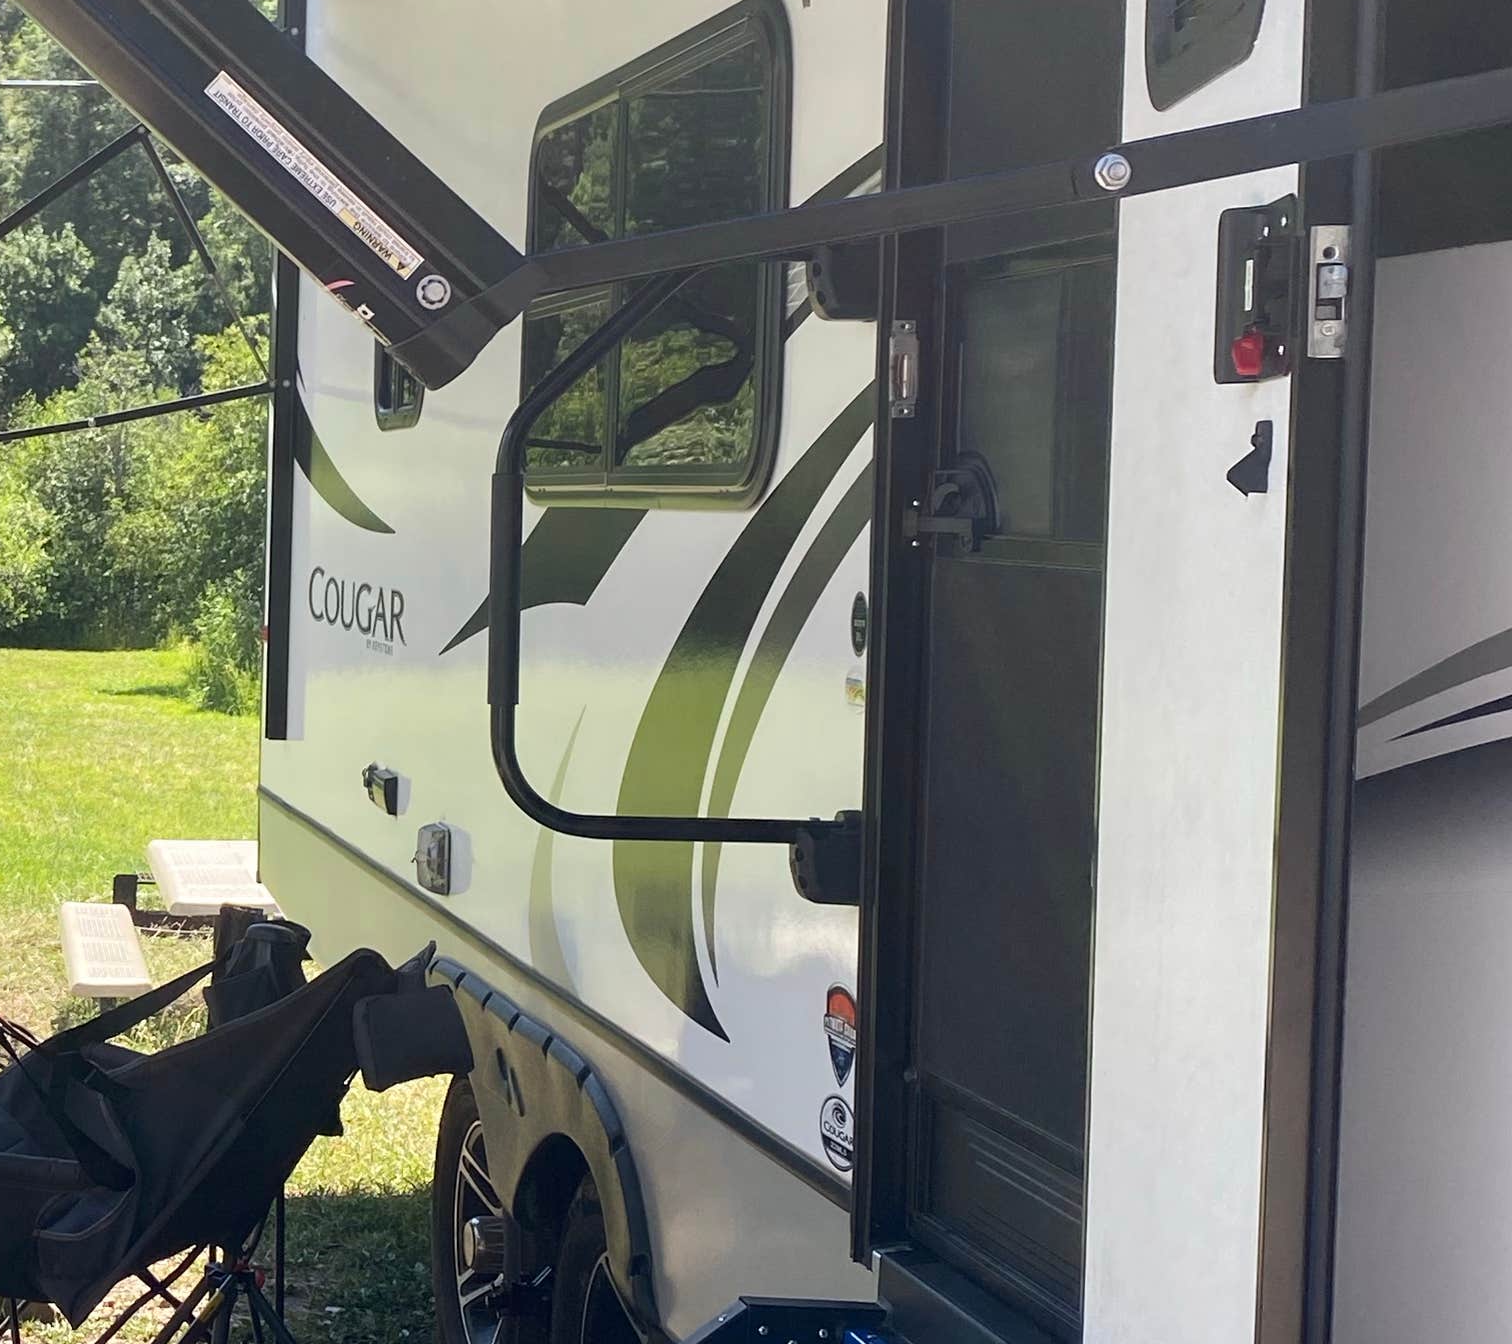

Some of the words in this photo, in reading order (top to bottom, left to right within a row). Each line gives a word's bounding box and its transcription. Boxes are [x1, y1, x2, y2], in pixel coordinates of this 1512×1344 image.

[212, 88, 243, 119] TRANSIT
[239, 114, 253, 128] TO
[250, 124, 274, 148] PRIOR
[270, 143, 293, 166] CARE
[289, 161, 324, 194] EXTREME
[320, 190, 338, 208] USE
[351, 219, 394, 261] WARNING
[308, 566, 407, 647] COUGAR
